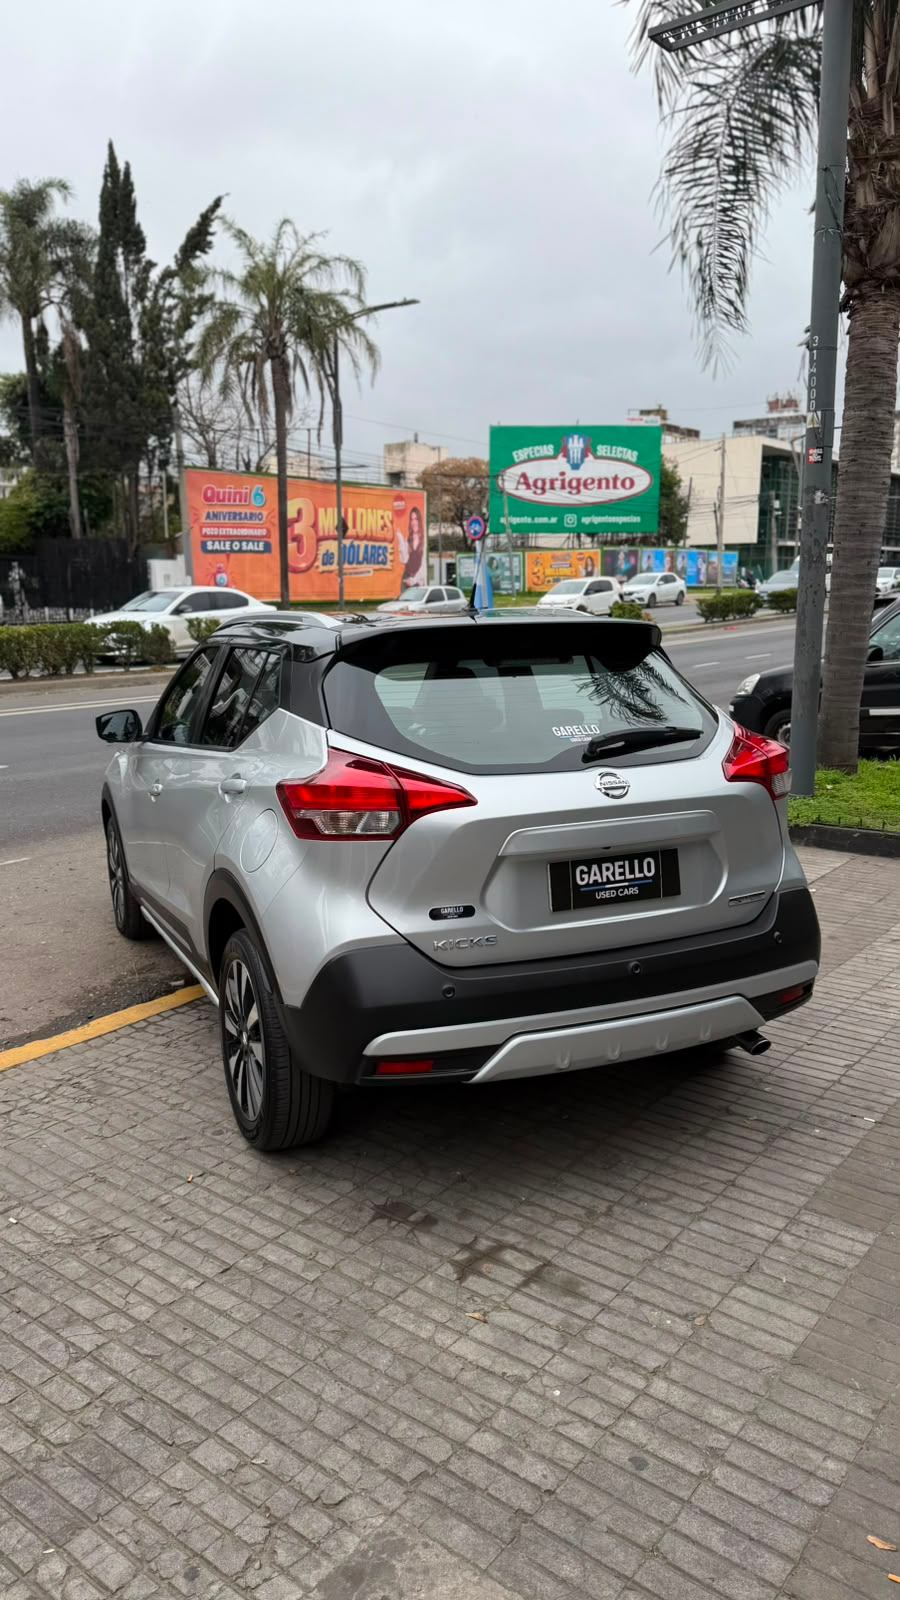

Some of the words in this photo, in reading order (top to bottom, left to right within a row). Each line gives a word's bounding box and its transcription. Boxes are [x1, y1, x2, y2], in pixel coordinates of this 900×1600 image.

[512, 444, 555, 463] ESPECIAS
[597, 444, 639, 463] SELECTAS
[515, 471, 636, 496] Agrigento
[202, 485, 249, 505] Quini
[251, 484, 266, 507] 6
[205, 511, 264, 522] ANIVERSARIO
[581, 515, 641, 526] agrigentoespecias
[288, 497, 318, 573] 3
[206, 540, 231, 551] SALE
[232, 540, 240, 551] O
[241, 541, 265, 551] SALE
[321, 550, 335, 567] de
[551, 723, 601, 737] GARELLO
[599, 779, 629, 787] NISSAN
[575, 857, 656, 887] GARELLO
[595, 889, 617, 900] USED
[617, 887, 639, 897] CARS
[432, 934, 497, 952] KICKS
